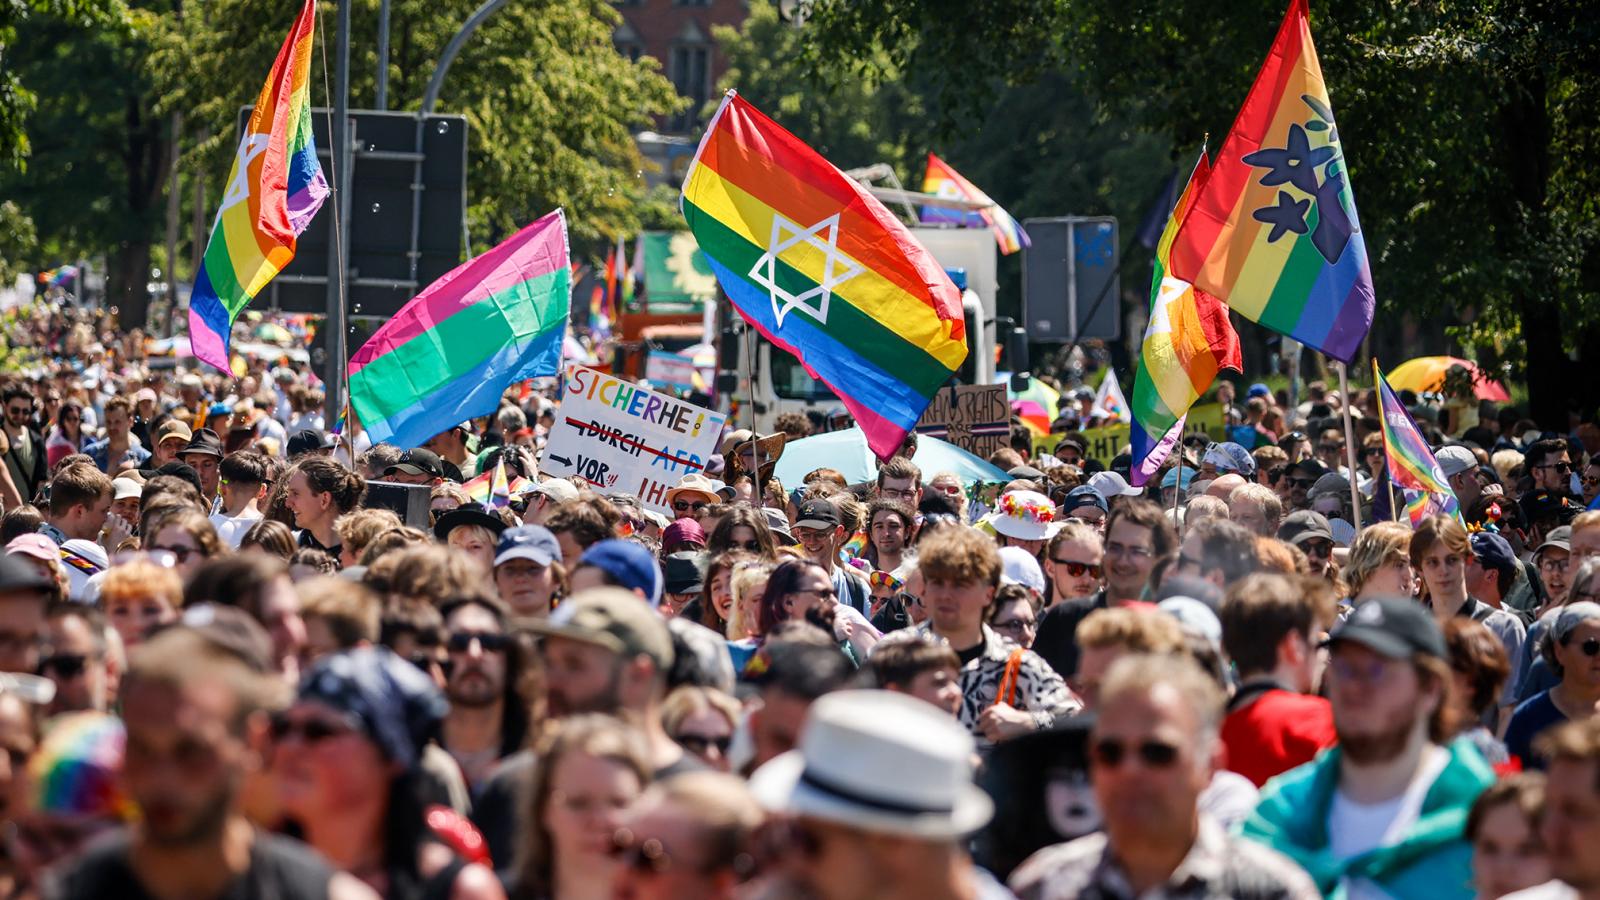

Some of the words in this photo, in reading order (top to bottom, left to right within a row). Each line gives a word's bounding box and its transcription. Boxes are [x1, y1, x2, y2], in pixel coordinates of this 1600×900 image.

[947, 424, 972, 433] ARE
[586, 420, 645, 457] DURCH
[651, 446, 702, 475] AFD
